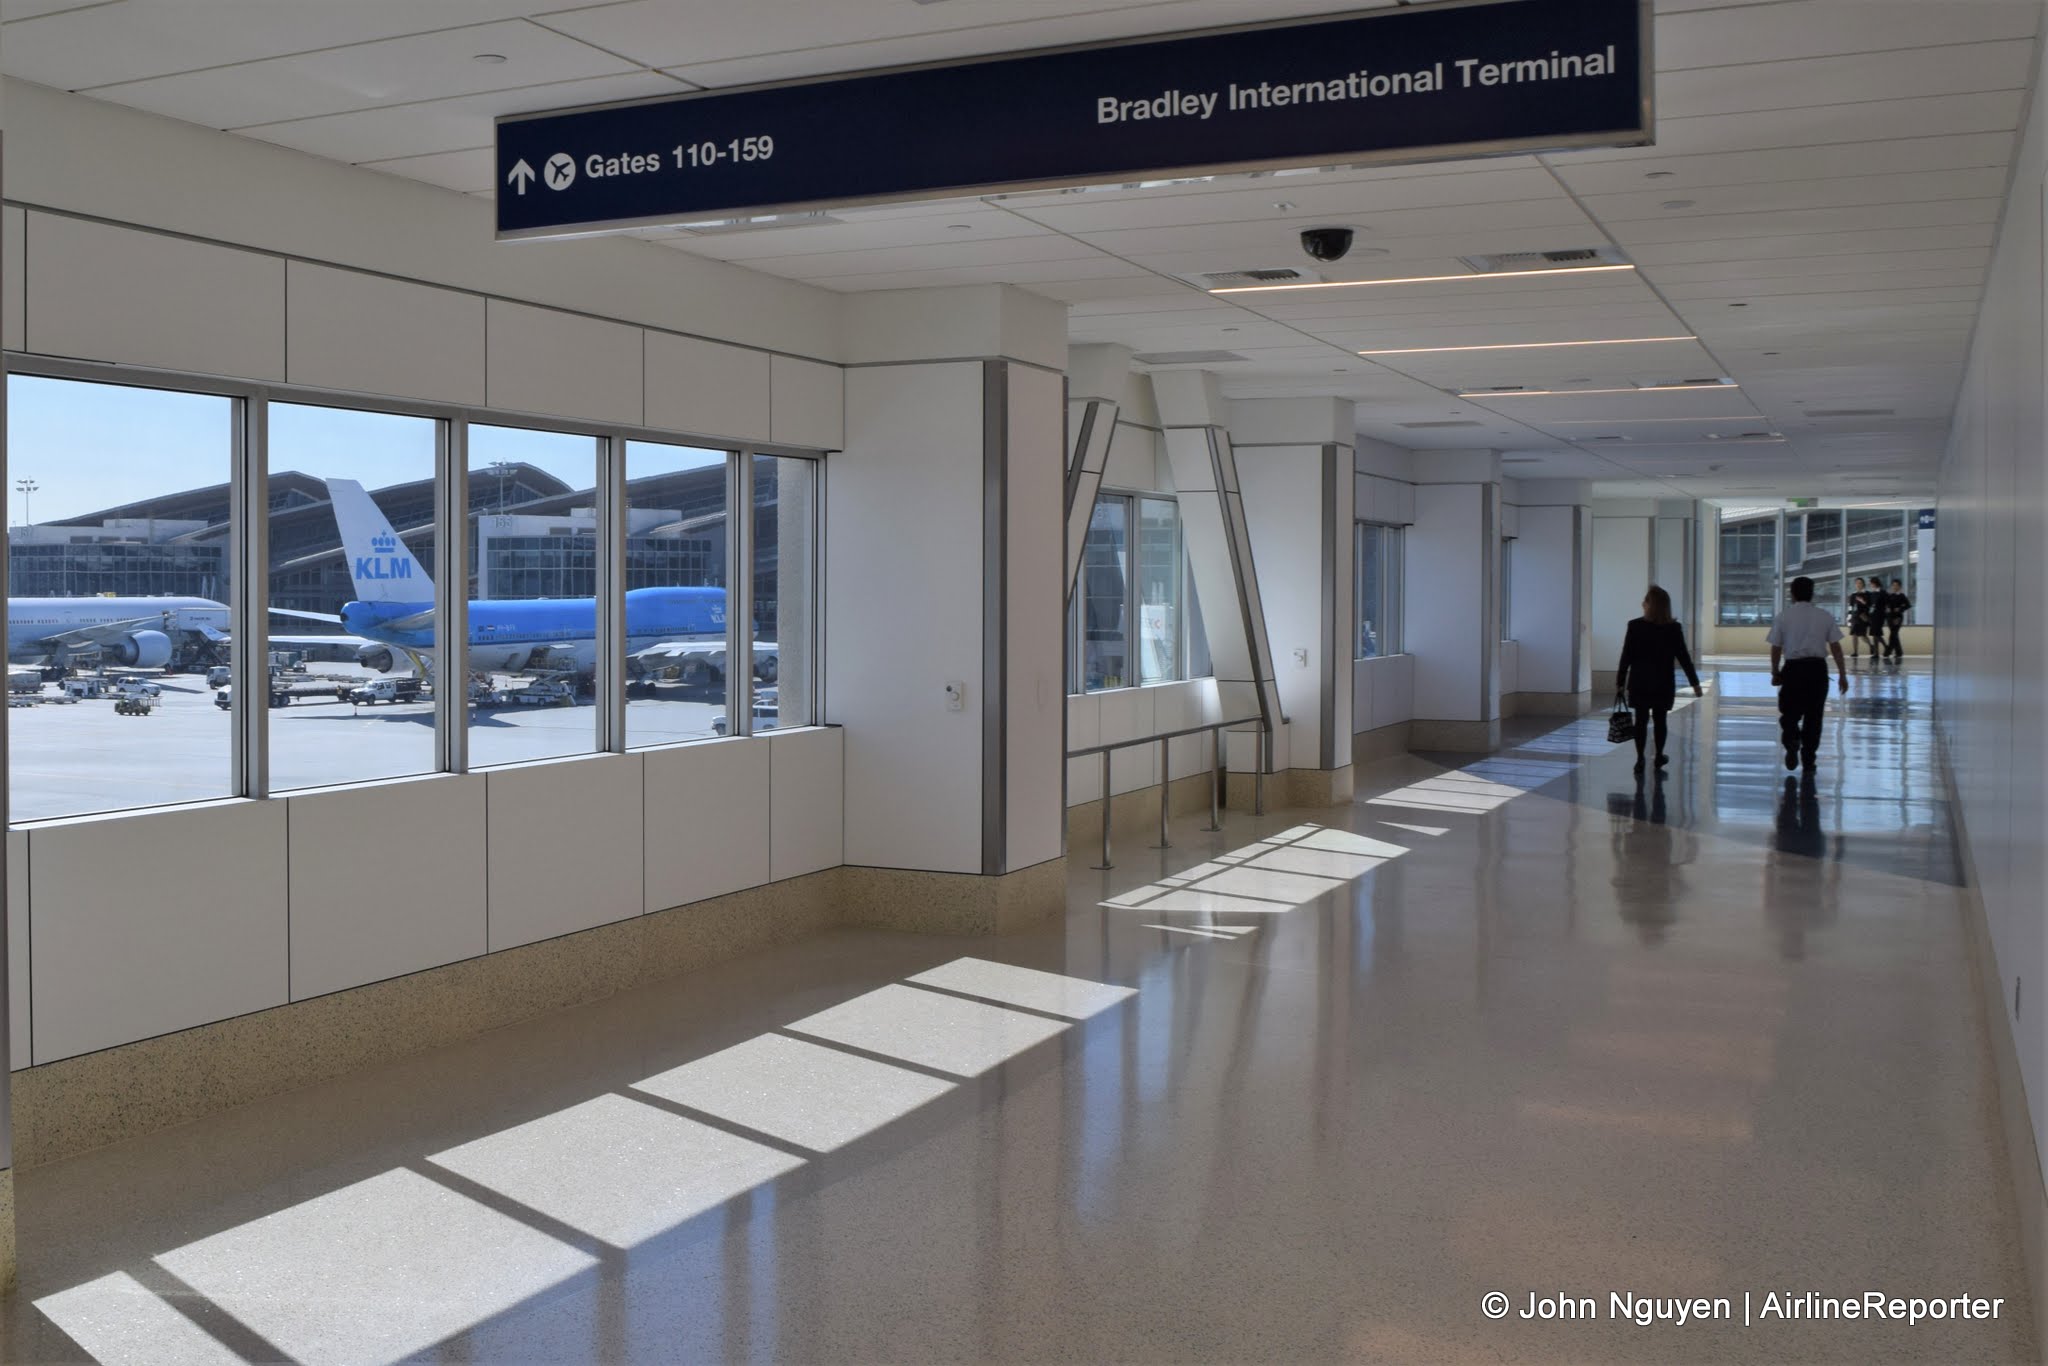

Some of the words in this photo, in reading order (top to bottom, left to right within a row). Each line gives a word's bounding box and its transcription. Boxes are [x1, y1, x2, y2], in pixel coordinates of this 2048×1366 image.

[1097, 89, 1218, 124] Bradley
[1229, 63, 1443, 110] International
[1454, 45, 1616, 89] Terminal
[584, 152, 661, 179] Gates
[672, 135, 774, 168] 110-159
[355, 557, 412, 580] KLM
